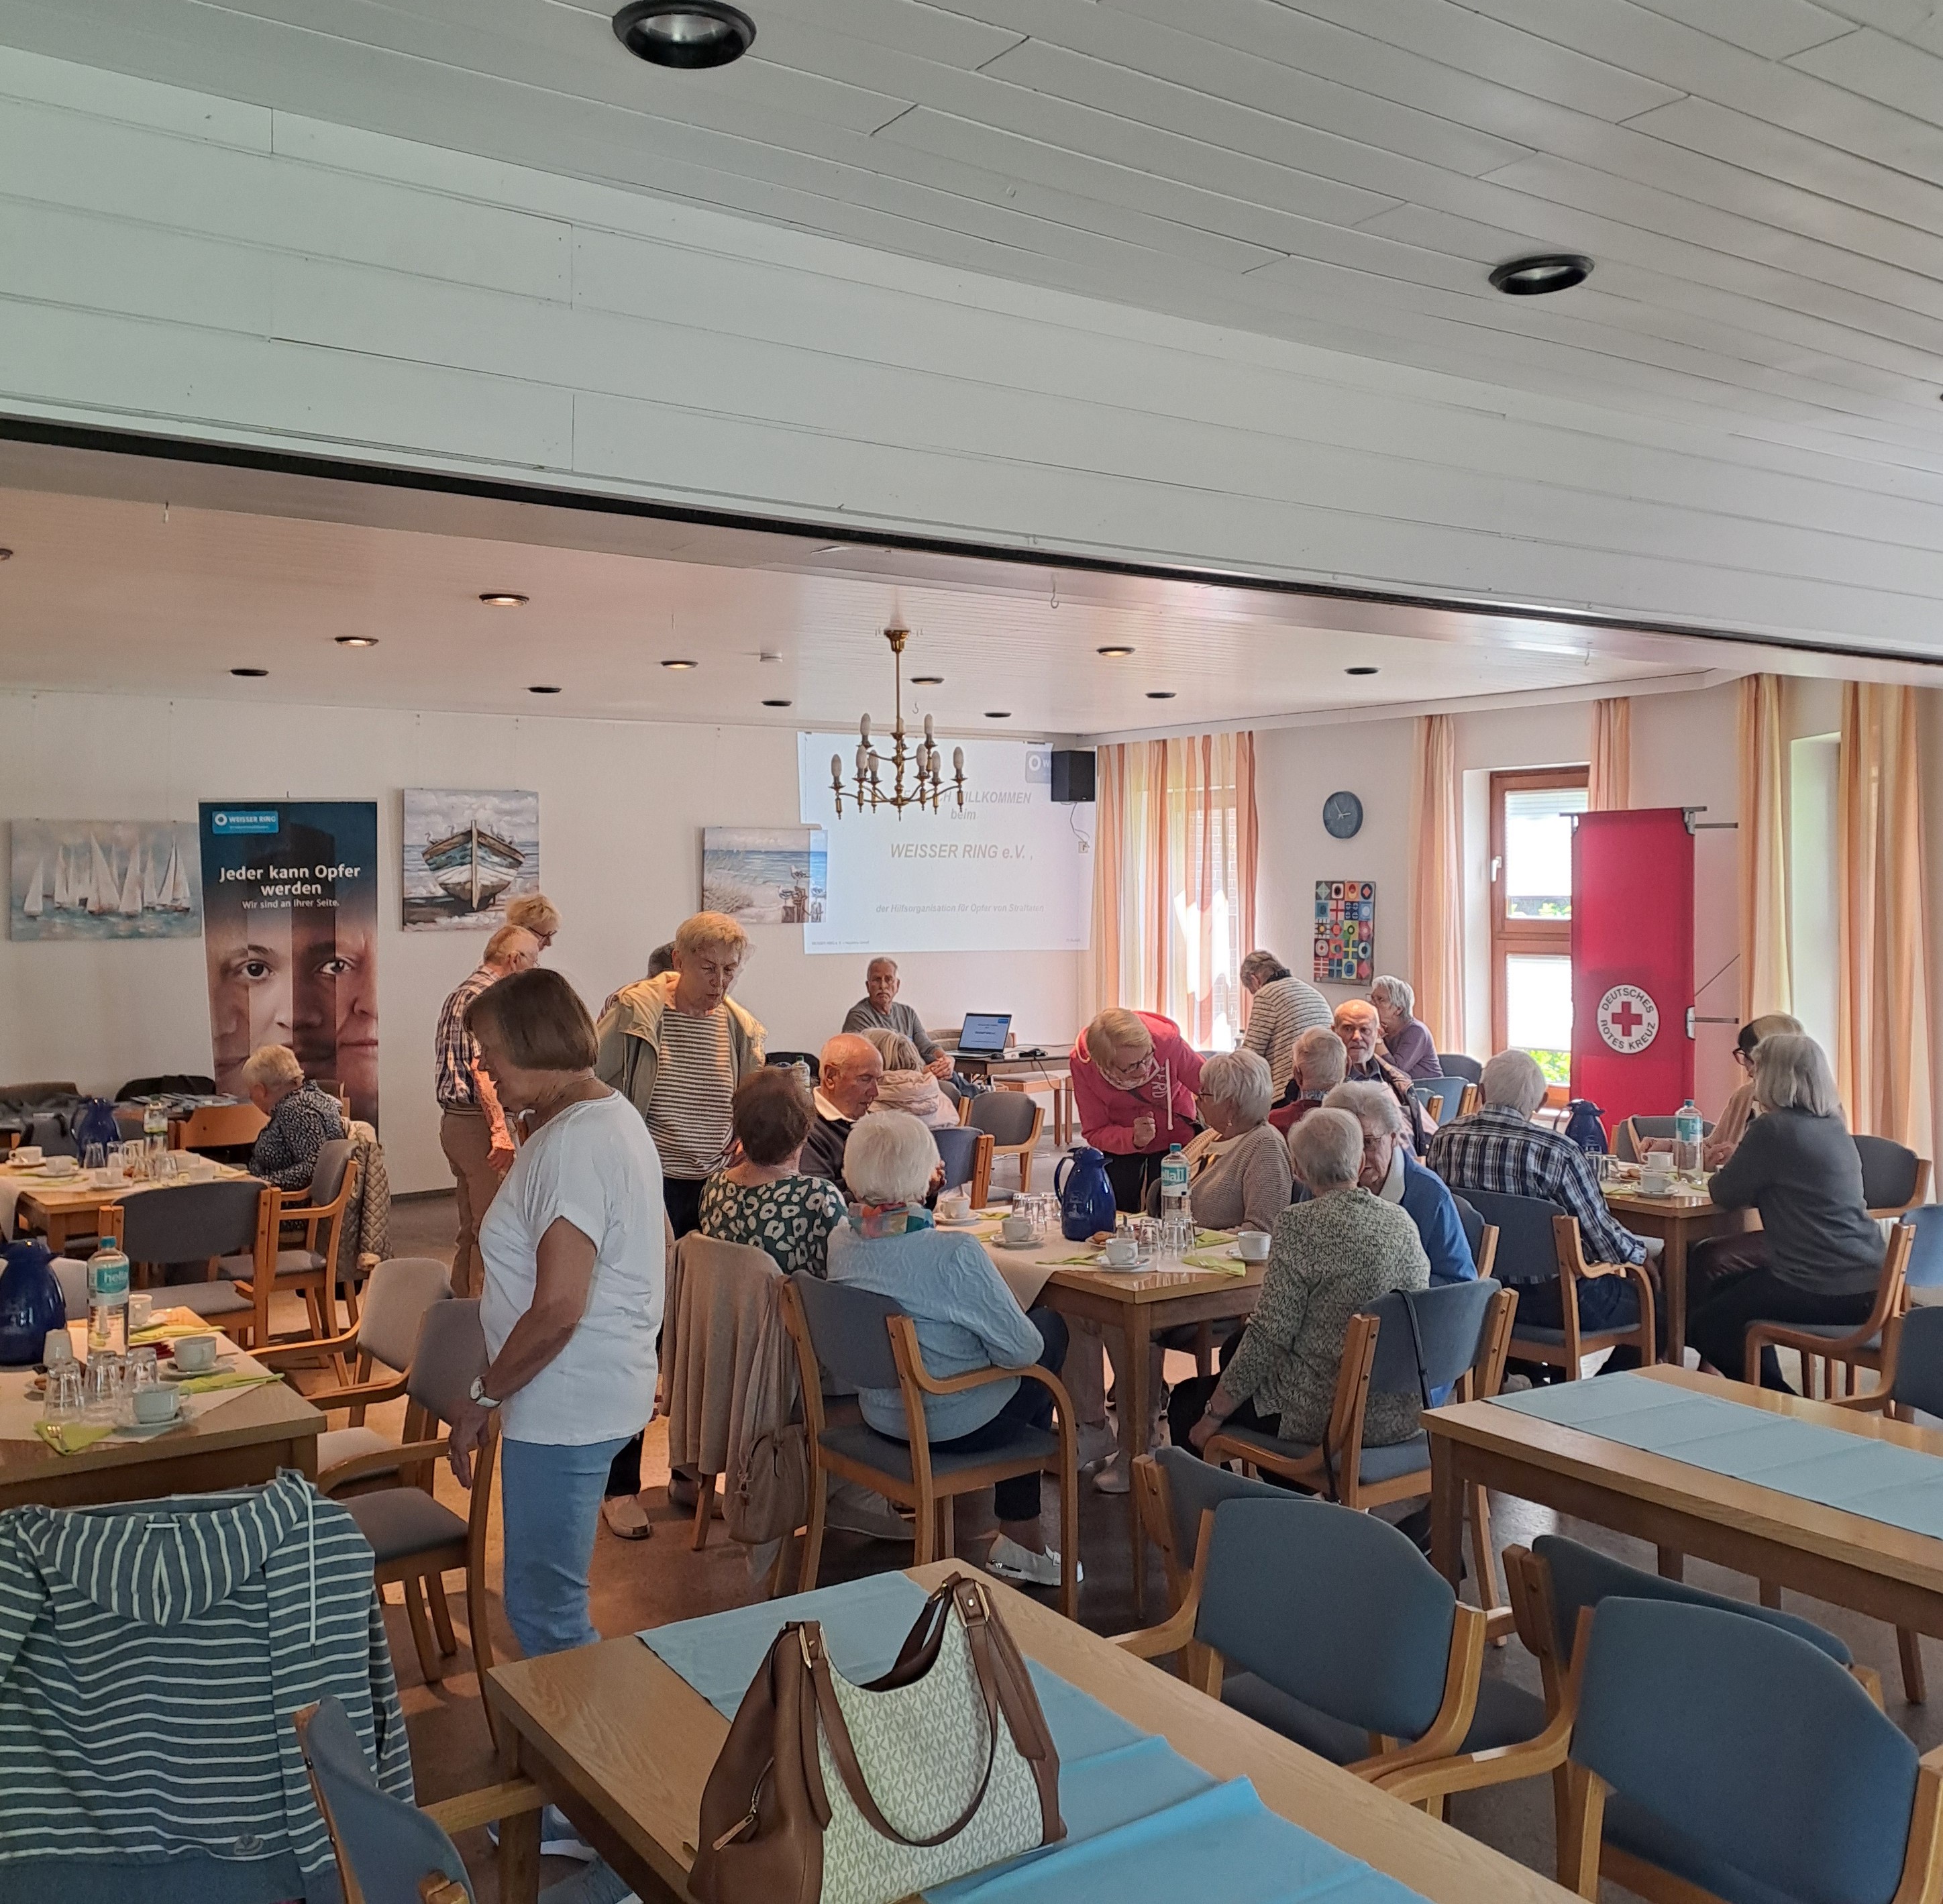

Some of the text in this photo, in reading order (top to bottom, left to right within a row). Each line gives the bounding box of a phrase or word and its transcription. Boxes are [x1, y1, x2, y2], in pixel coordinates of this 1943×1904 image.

[955, 790, 1033, 804] ILLKOMMEN
[950, 808, 977, 821] beim
[890, 843, 959, 859] WEISSER
[962, 843, 998, 859] RING
[1002, 845, 1026, 859] e.V.
[219, 863, 361, 883] Jeder kann Opfer
[260, 881, 322, 896] werden
[242, 900, 258, 909] Wir
[260, 900, 278, 908] sind
[293, 899, 314, 907] Ihrer
[316, 898, 339, 907] Seite.
[876, 904, 888, 912] der
[890, 904, 956, 914] Hilfsorganisation
[957, 904, 969, 912] für
[970, 904, 993, 914] Opfer
[1602, 988, 1654, 1014] DEUTSCHES
[1600, 1019, 1656, 1051] ROTES KREUZ
